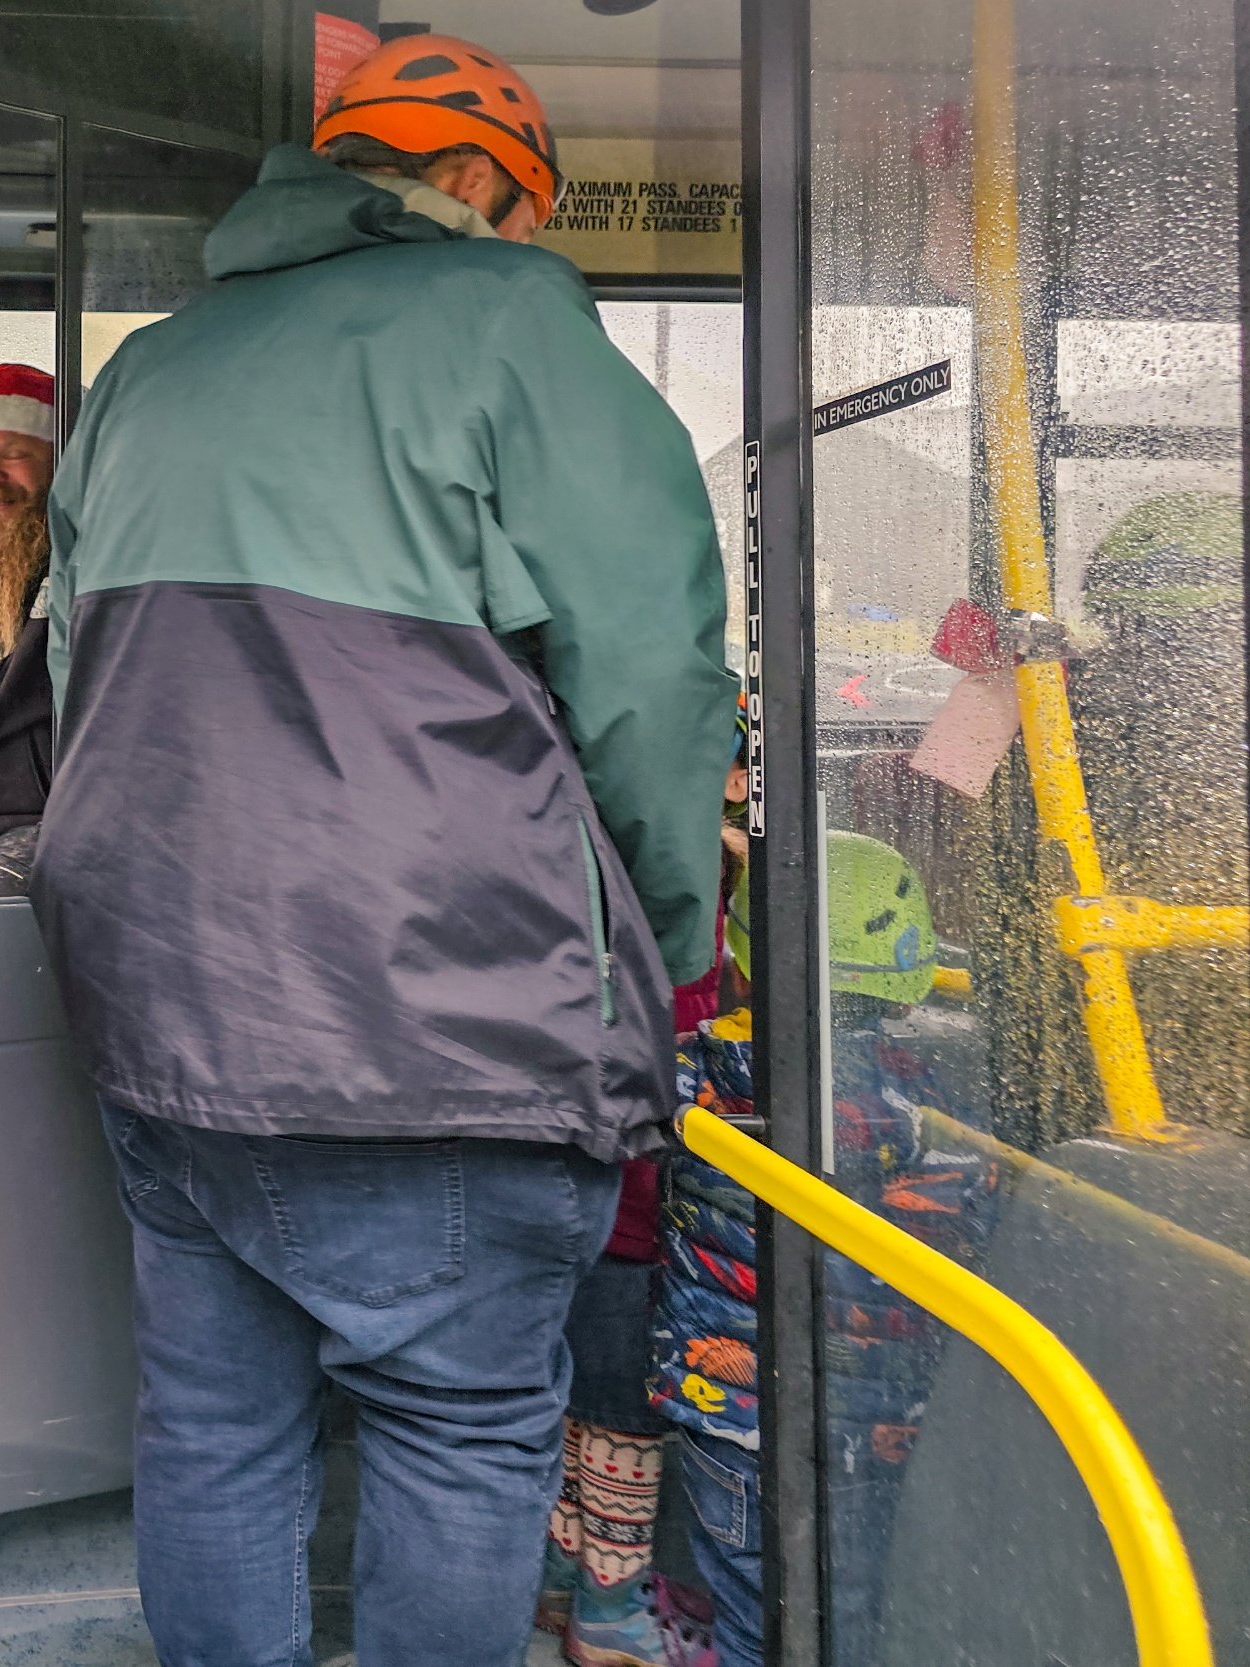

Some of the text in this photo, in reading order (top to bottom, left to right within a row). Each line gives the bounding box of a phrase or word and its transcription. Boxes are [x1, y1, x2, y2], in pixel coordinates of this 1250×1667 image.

[564, 181, 632, 197] AXIMUM
[639, 182, 680, 198] PASS.
[573, 198, 614, 214] WITH
[621, 200, 637, 215] 21
[646, 200, 726, 216] STANDEES
[567, 215, 609, 231] WITH
[618, 216, 633, 231] 17
[642, 217, 721, 233] STANDEES
[814, 366, 950, 430] IN EMERGENCY ONLY
[747, 455, 762, 833] PULL TO OPEN
